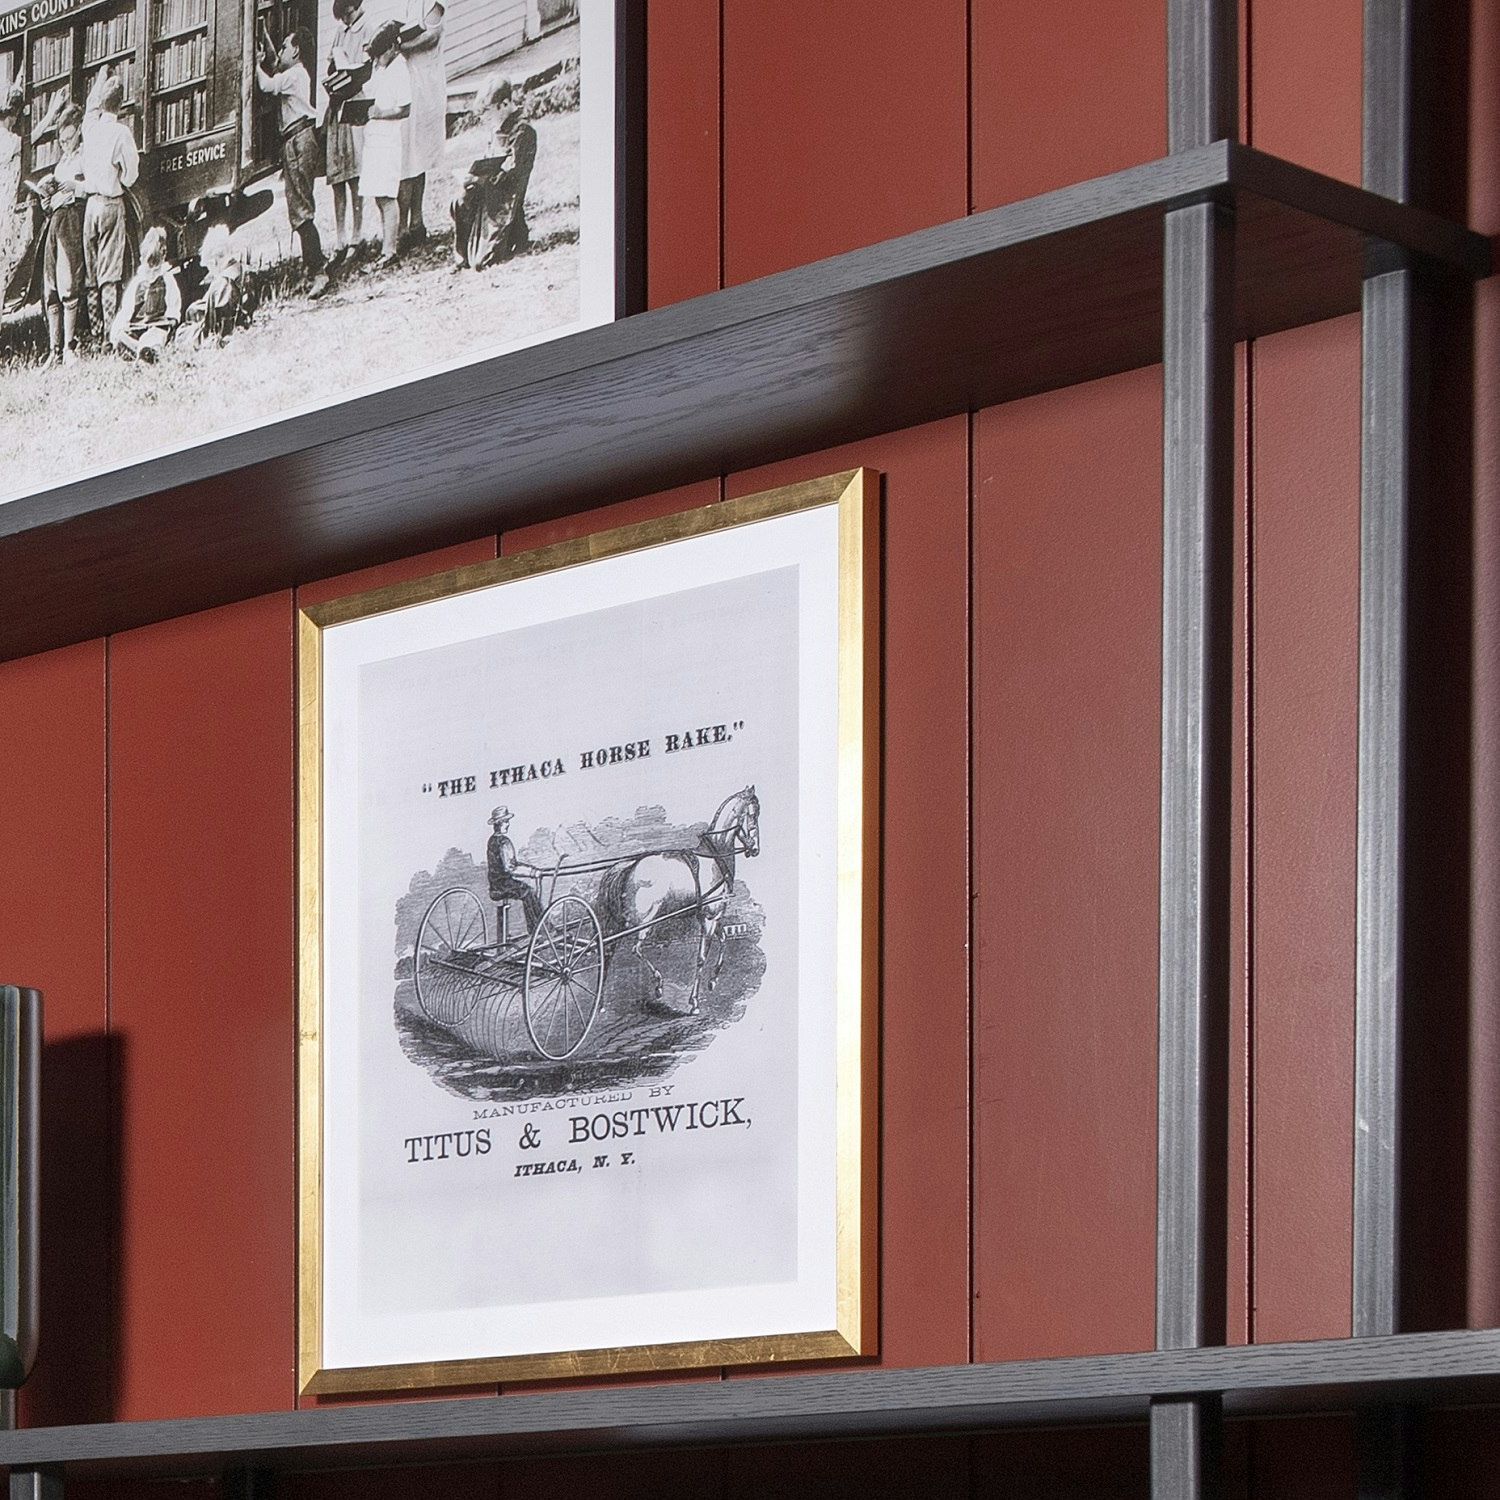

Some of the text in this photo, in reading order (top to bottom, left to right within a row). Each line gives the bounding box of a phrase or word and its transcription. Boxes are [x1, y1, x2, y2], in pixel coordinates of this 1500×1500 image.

[31, 0, 83, 22] COUN
[160, 143, 227, 174] FREE SERVICE
[488, 757, 567, 789] ITHACA
[579, 739, 651, 770] HORSE
[472, 1084, 676, 1121] MANUFACTURED BY
[404, 1097, 753, 1164] TITUS & BOSTWICK,
[513, 1151, 637, 1179] ITHACA, N. Y.
